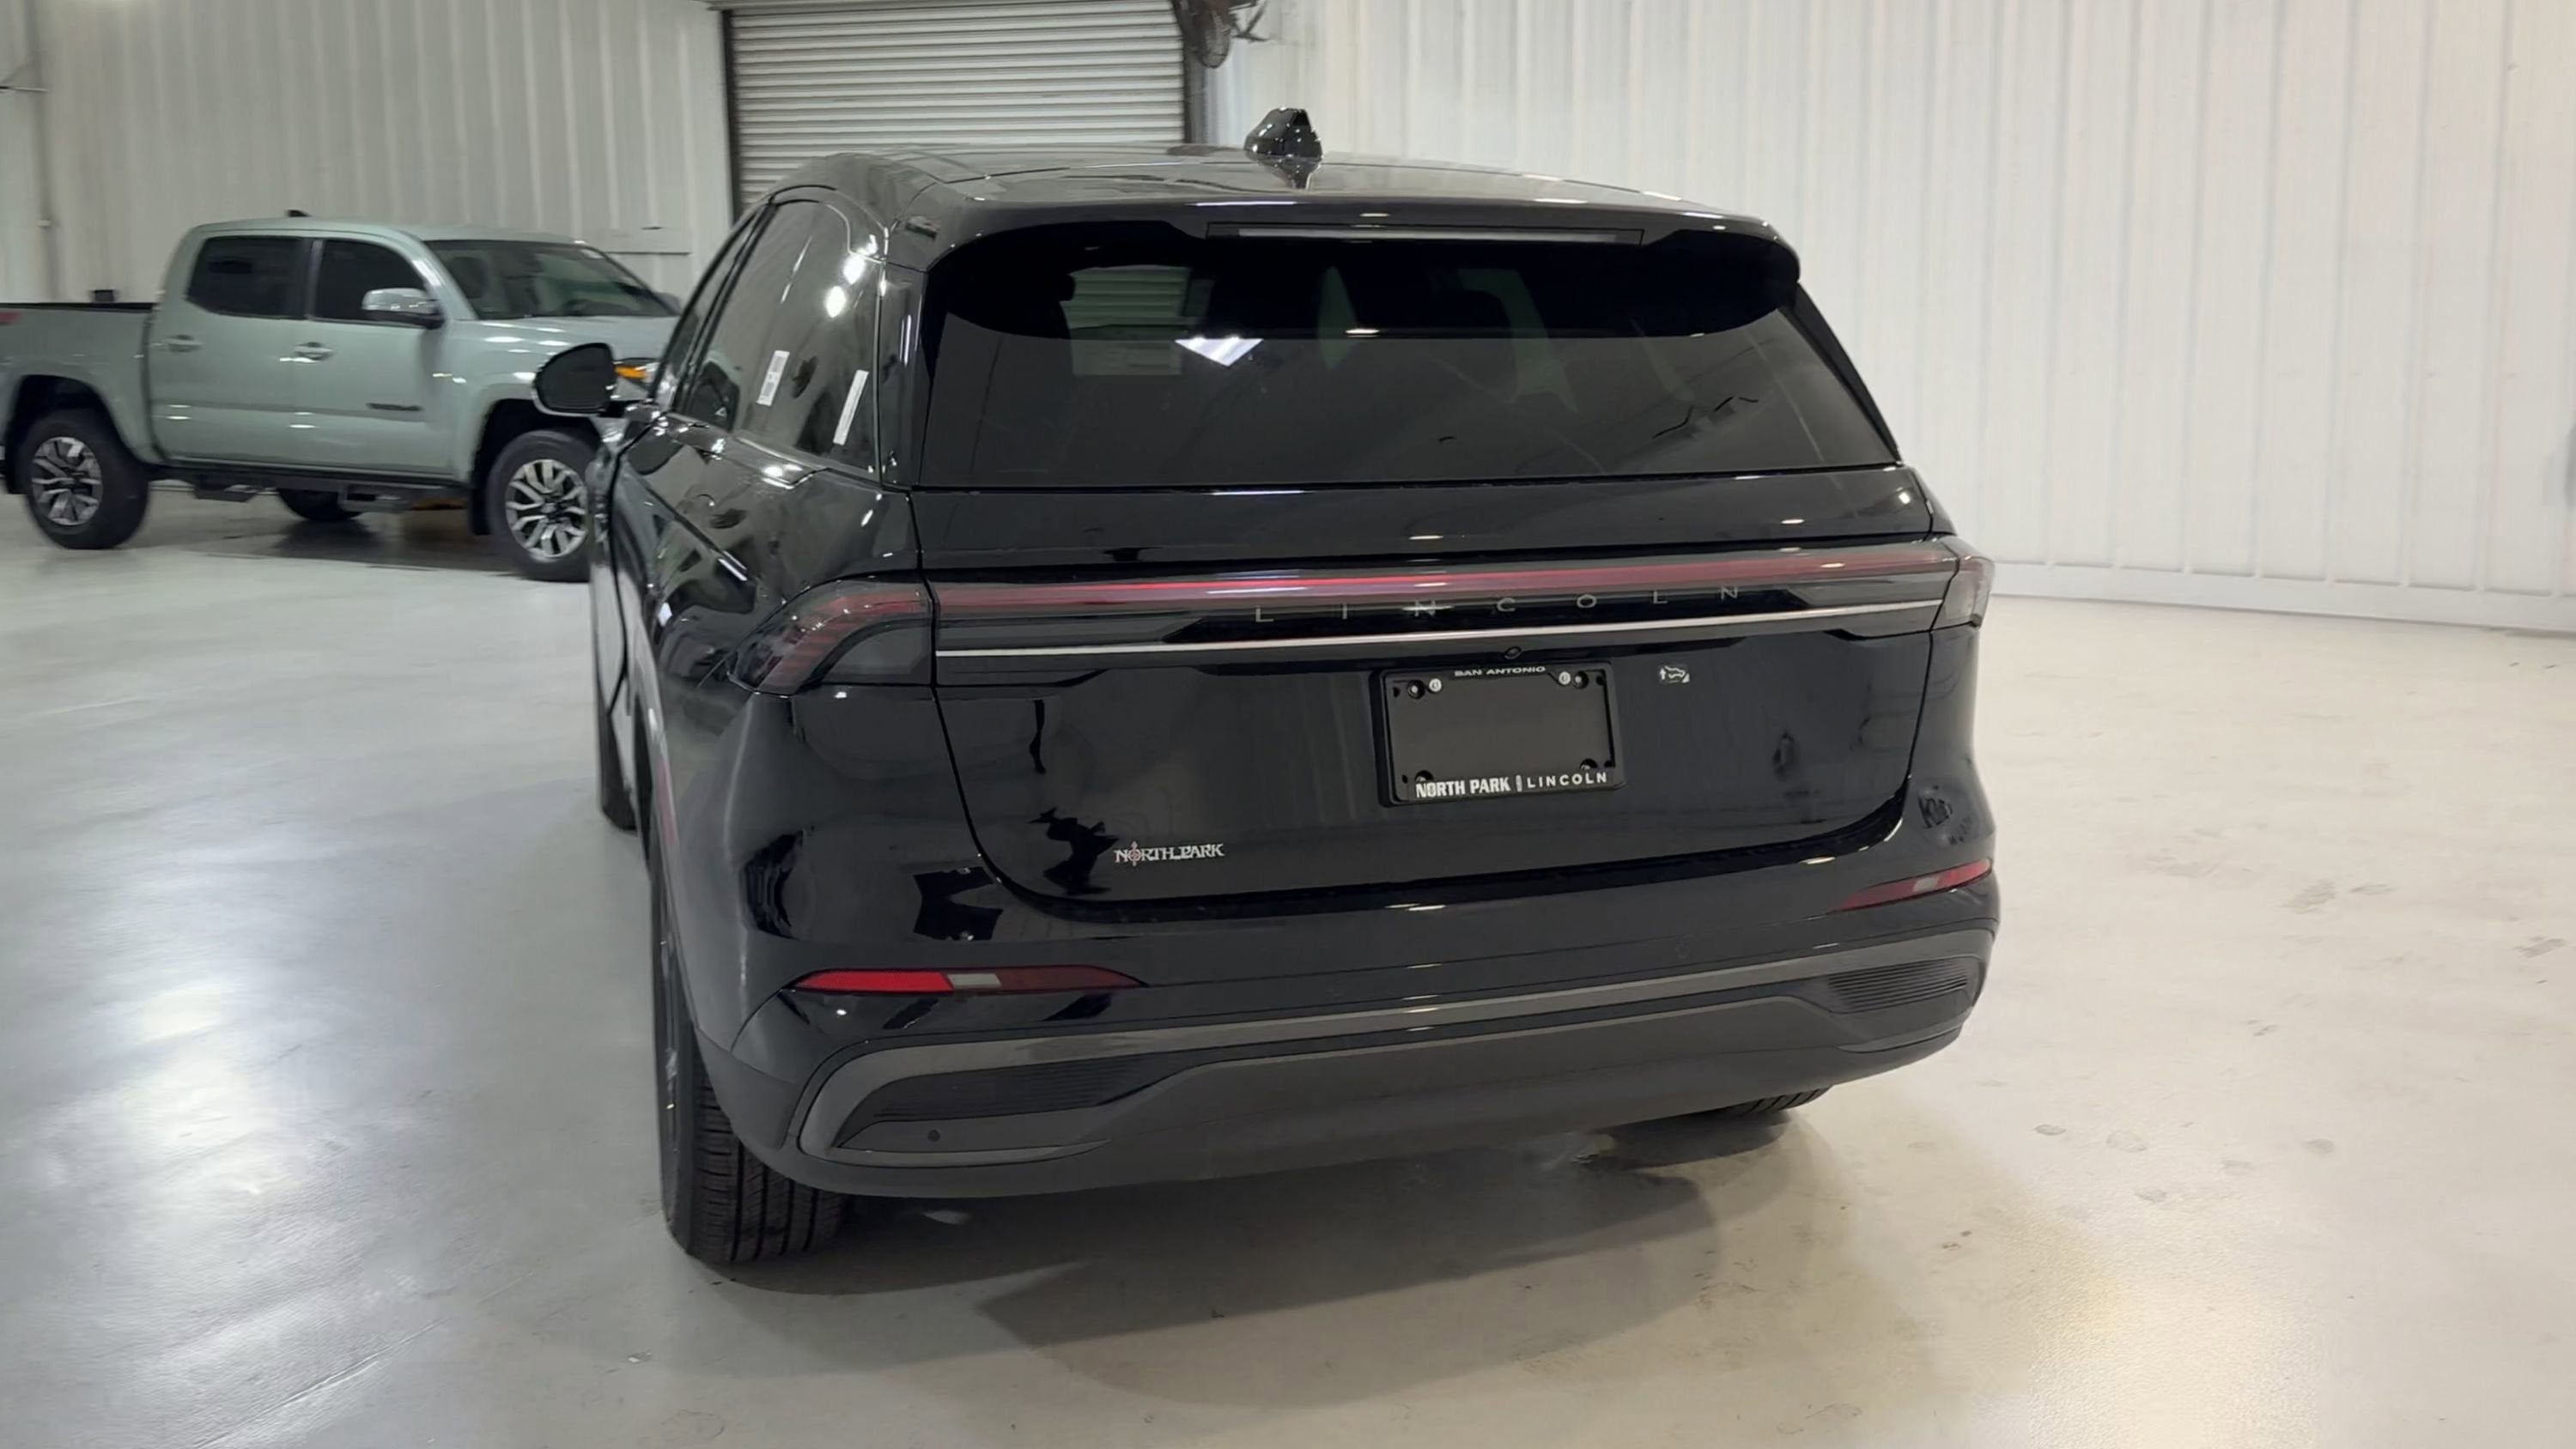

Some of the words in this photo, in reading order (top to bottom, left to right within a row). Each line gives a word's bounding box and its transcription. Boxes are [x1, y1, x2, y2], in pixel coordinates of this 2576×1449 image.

[1255, 585, 1739, 622] LINCOLN
[1454, 669, 1483, 677] SAN
[1485, 665, 1546, 676] ANTONIO
[1415, 779, 1466, 798] NORTH
[1469, 776, 1511, 794] PARK
[1526, 772, 1608, 789] LINCOLN
